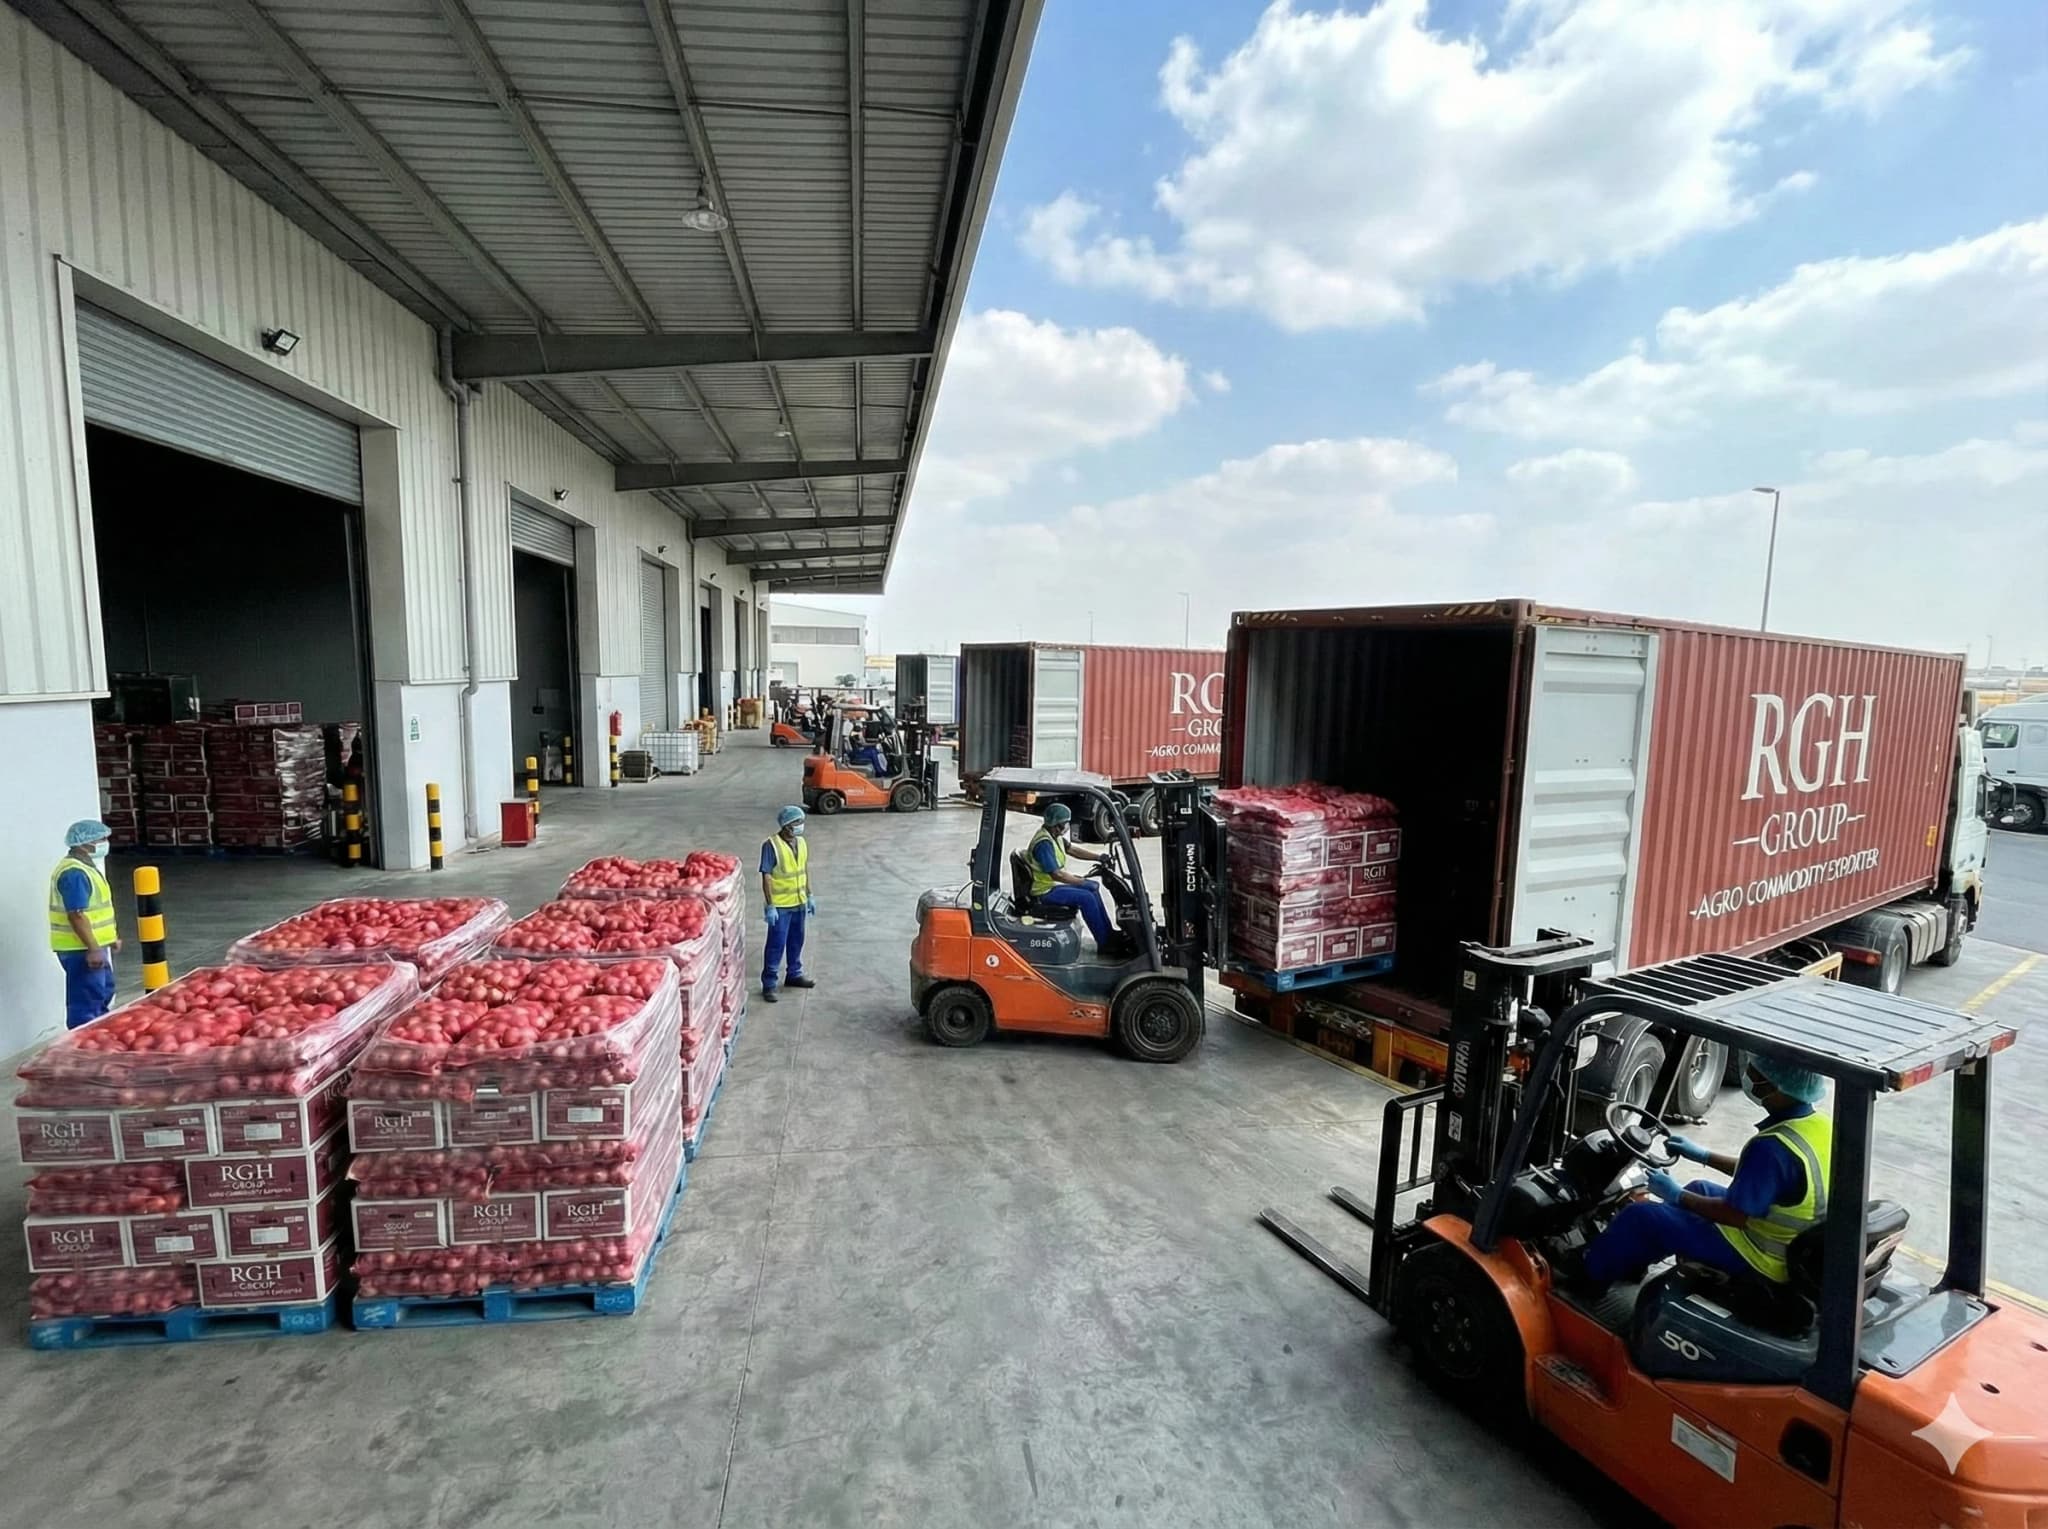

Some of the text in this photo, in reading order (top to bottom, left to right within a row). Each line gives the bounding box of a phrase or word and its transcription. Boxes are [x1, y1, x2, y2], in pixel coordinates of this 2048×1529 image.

[1741, 692, 1877, 800] RGH
[1760, 803, 1848, 856] GROUP
[41, 1122, 86, 1138] RGH
[374, 1115, 413, 1128] RGH
[220, 1163, 274, 1181] RGH
[473, 1203, 513, 1218] RGH
[51, 1228, 95, 1244] RGH
[229, 1264, 282, 1282] RGH
[1658, 1330, 1700, 1360] 50
